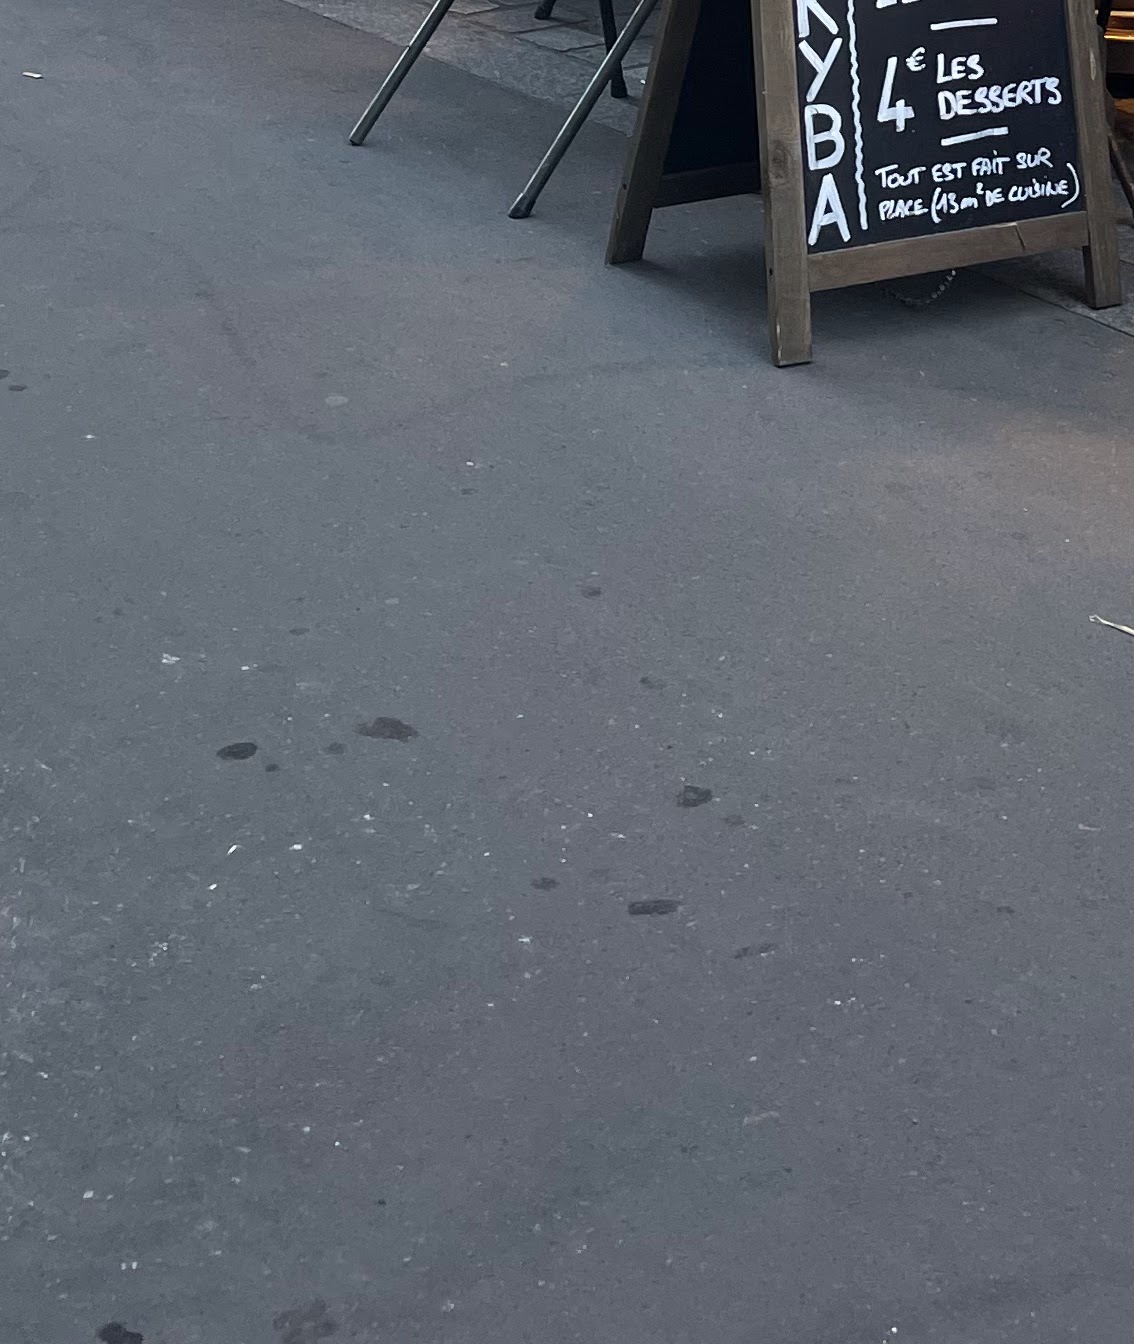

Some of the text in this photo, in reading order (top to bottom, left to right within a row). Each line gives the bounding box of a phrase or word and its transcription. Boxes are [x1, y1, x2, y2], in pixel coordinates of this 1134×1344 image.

[936, 52, 984, 81] LES
[937, 76, 1063, 124] DESSERTS
[874, 147, 1054, 188] TOUT EST FAIT SUR
[878, 198, 929, 221] PLACE
